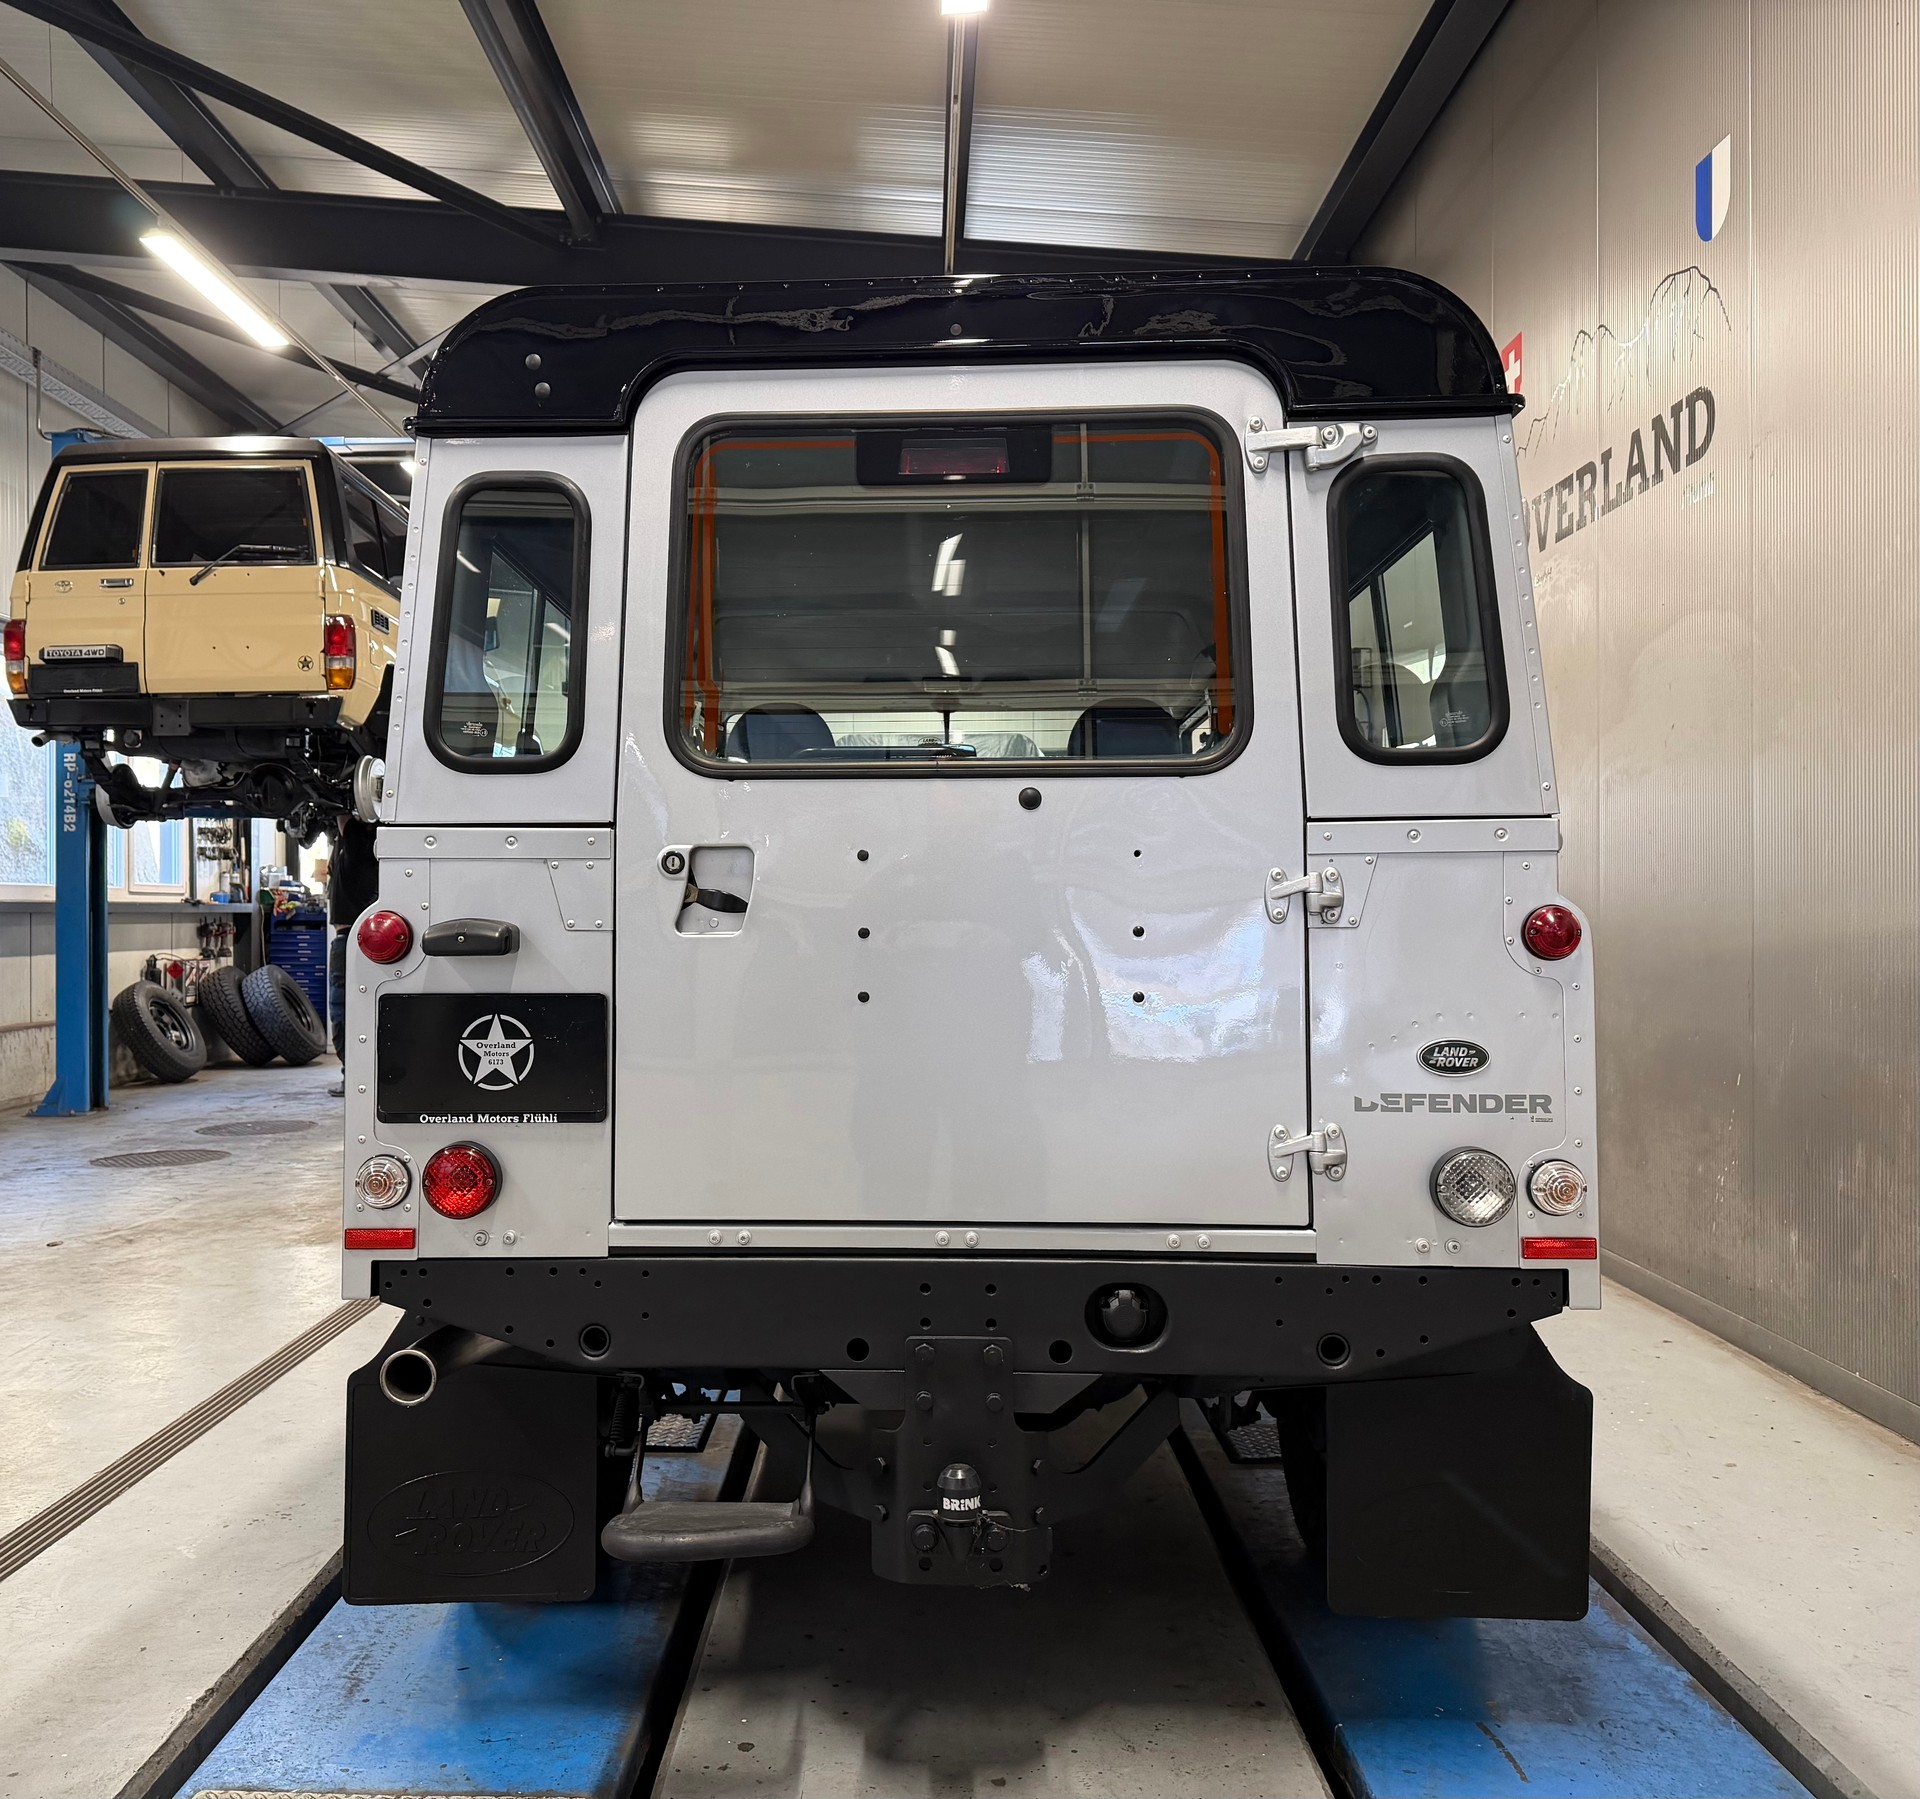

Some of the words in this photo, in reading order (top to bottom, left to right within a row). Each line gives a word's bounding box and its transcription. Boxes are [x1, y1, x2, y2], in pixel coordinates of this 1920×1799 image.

[1521, 385, 1716, 553] VERLAND
[476, 1041, 516, 1049] Overland
[488, 1058, 504, 1066] 6173
[419, 1113, 474, 1124] Overland
[477, 1113, 519, 1124] Motors
[522, 1113, 558, 1124] Flühli
